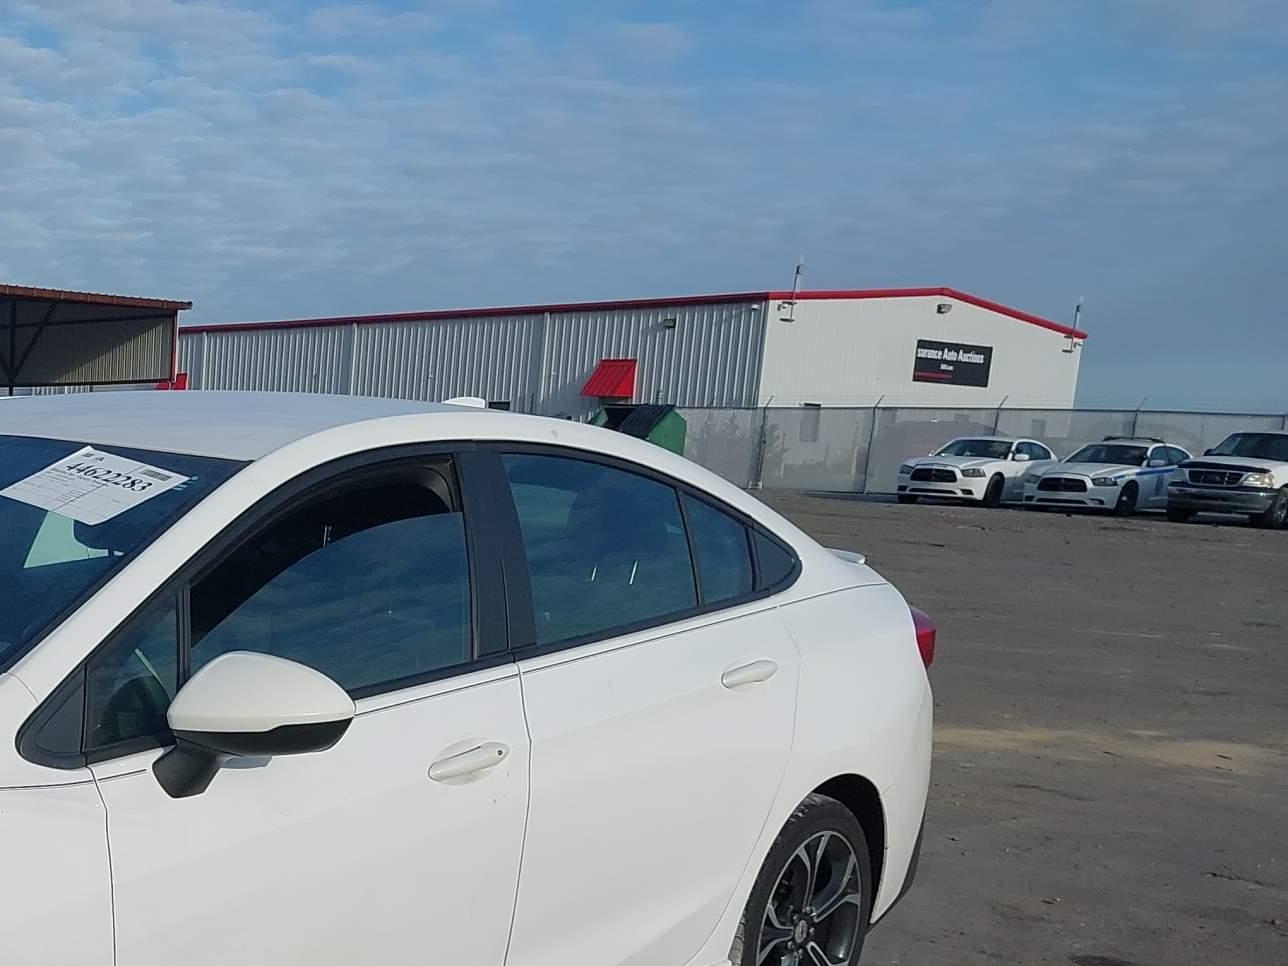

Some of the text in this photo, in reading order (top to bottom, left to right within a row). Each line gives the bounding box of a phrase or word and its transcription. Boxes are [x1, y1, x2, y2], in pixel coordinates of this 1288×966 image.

[943, 347, 957, 361] Auto
[958, 349, 984, 363] Auctions
[65, 462, 153, 492] 44622283
